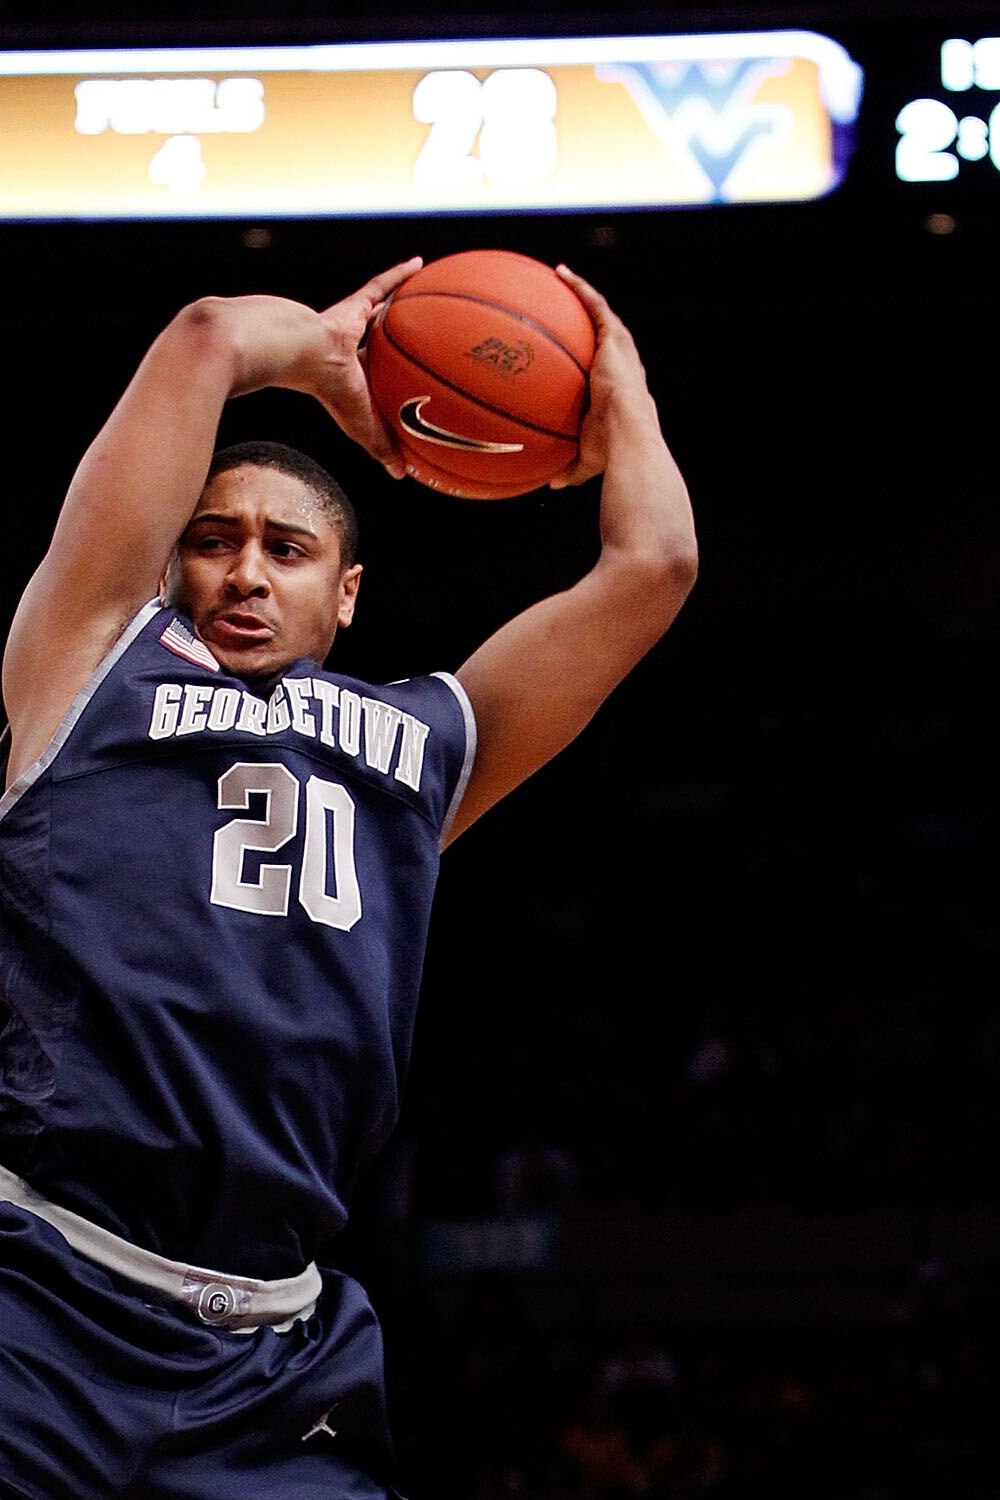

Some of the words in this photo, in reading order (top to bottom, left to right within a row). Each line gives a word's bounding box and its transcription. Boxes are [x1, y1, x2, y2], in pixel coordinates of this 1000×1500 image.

[148, 676, 431, 792] GEORGETOWN
[209, 761, 363, 932] 20
[207, 1291, 230, 1314] G
